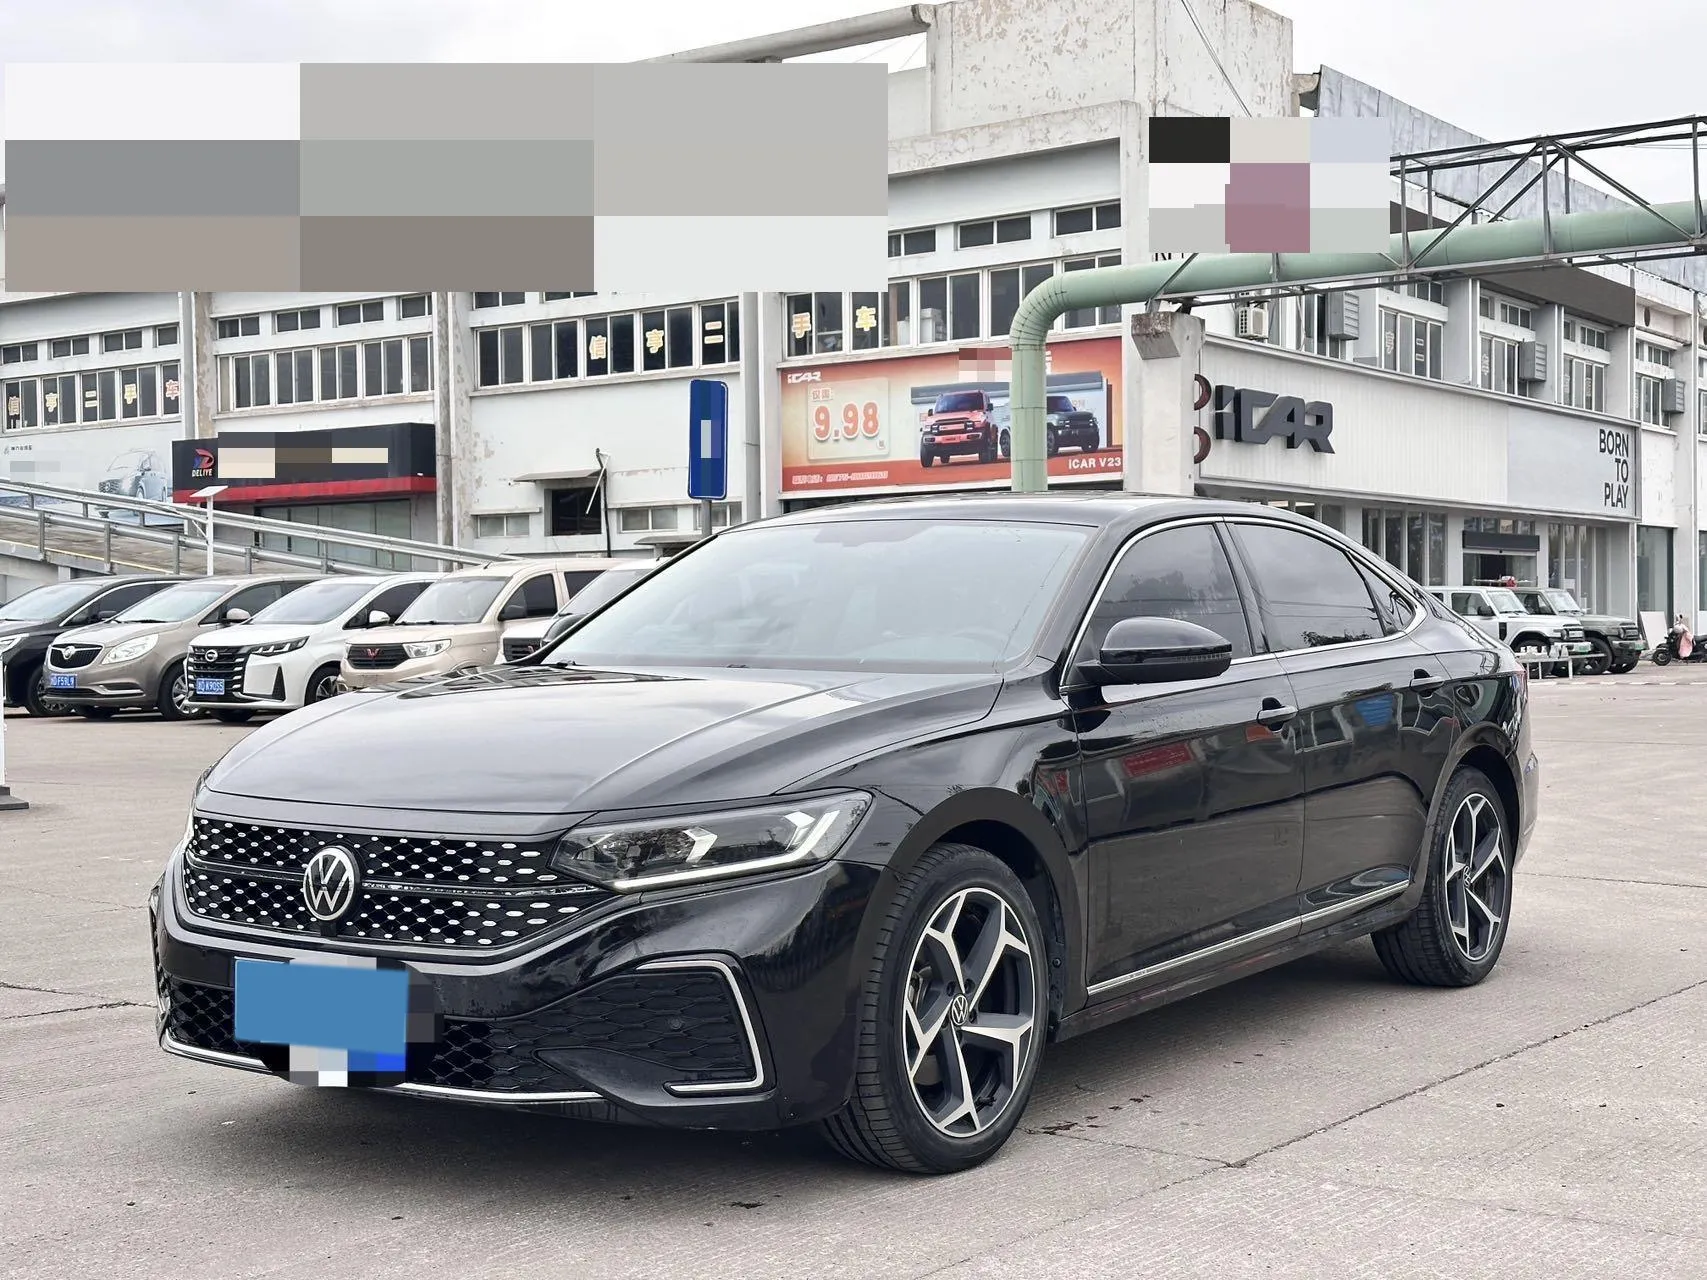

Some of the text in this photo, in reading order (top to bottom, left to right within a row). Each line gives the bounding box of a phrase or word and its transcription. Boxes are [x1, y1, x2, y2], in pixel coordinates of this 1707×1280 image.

[813, 400, 881, 441] 9.98
[1600, 428, 1629, 458] BORN
[1098, 456, 1122, 468] V23
[1615, 457, 1629, 483] TO
[1604, 481, 1629, 509] PLAY
